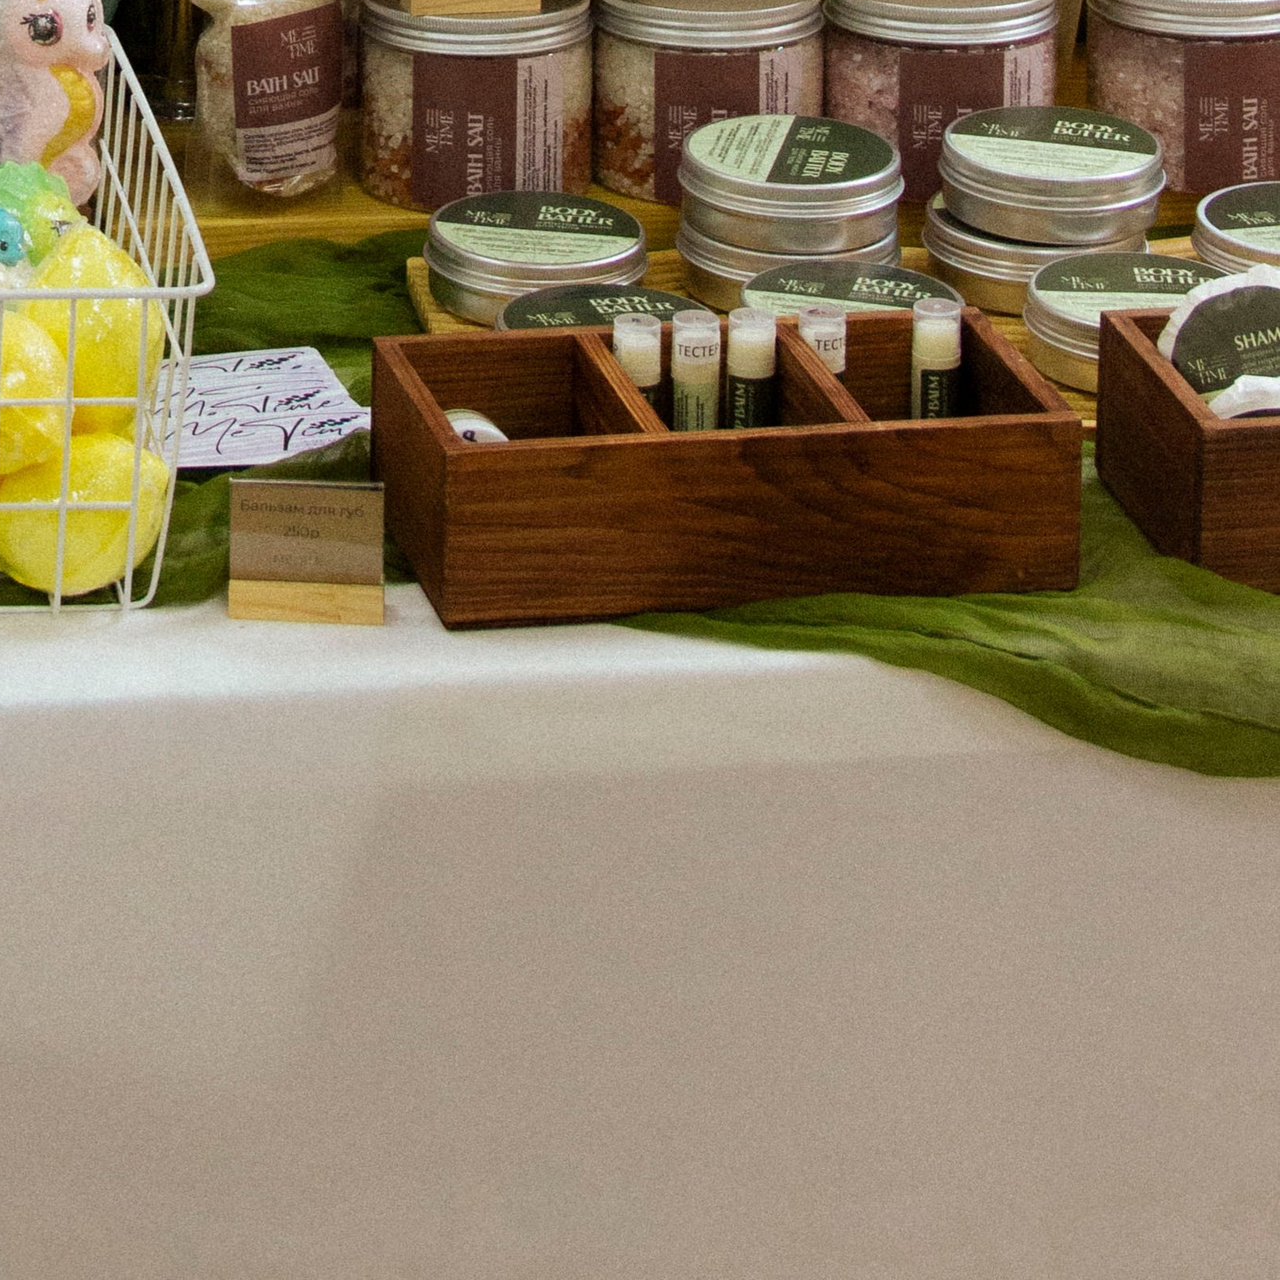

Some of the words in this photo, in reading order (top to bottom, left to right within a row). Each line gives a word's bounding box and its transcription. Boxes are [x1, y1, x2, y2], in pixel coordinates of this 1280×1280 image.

[247, 75, 287, 96] BATH
[293, 66, 320, 87] SALT
[1242, 95, 1258, 131] SALT
[467, 111, 484, 147] SALT
[1055, 120, 1118, 133] BODY
[1053, 127, 1131, 142] BUTTER
[1242, 137, 1258, 180] BATH
[467, 153, 484, 195] BATH
[541, 205, 601, 217] BODY
[538, 213, 614, 226] BATTER
[1133, 267, 1195, 277] BODY
[856, 277, 920, 290] BODY
[589, 295, 649, 307] BODY
[595, 301, 675, 314] BATTER
[814, 337, 844, 352] ТЕСТ
[928, 375, 940, 411] BALM
[240, 498, 304, 515] Бальзам
[339, 505, 365, 519] губ
